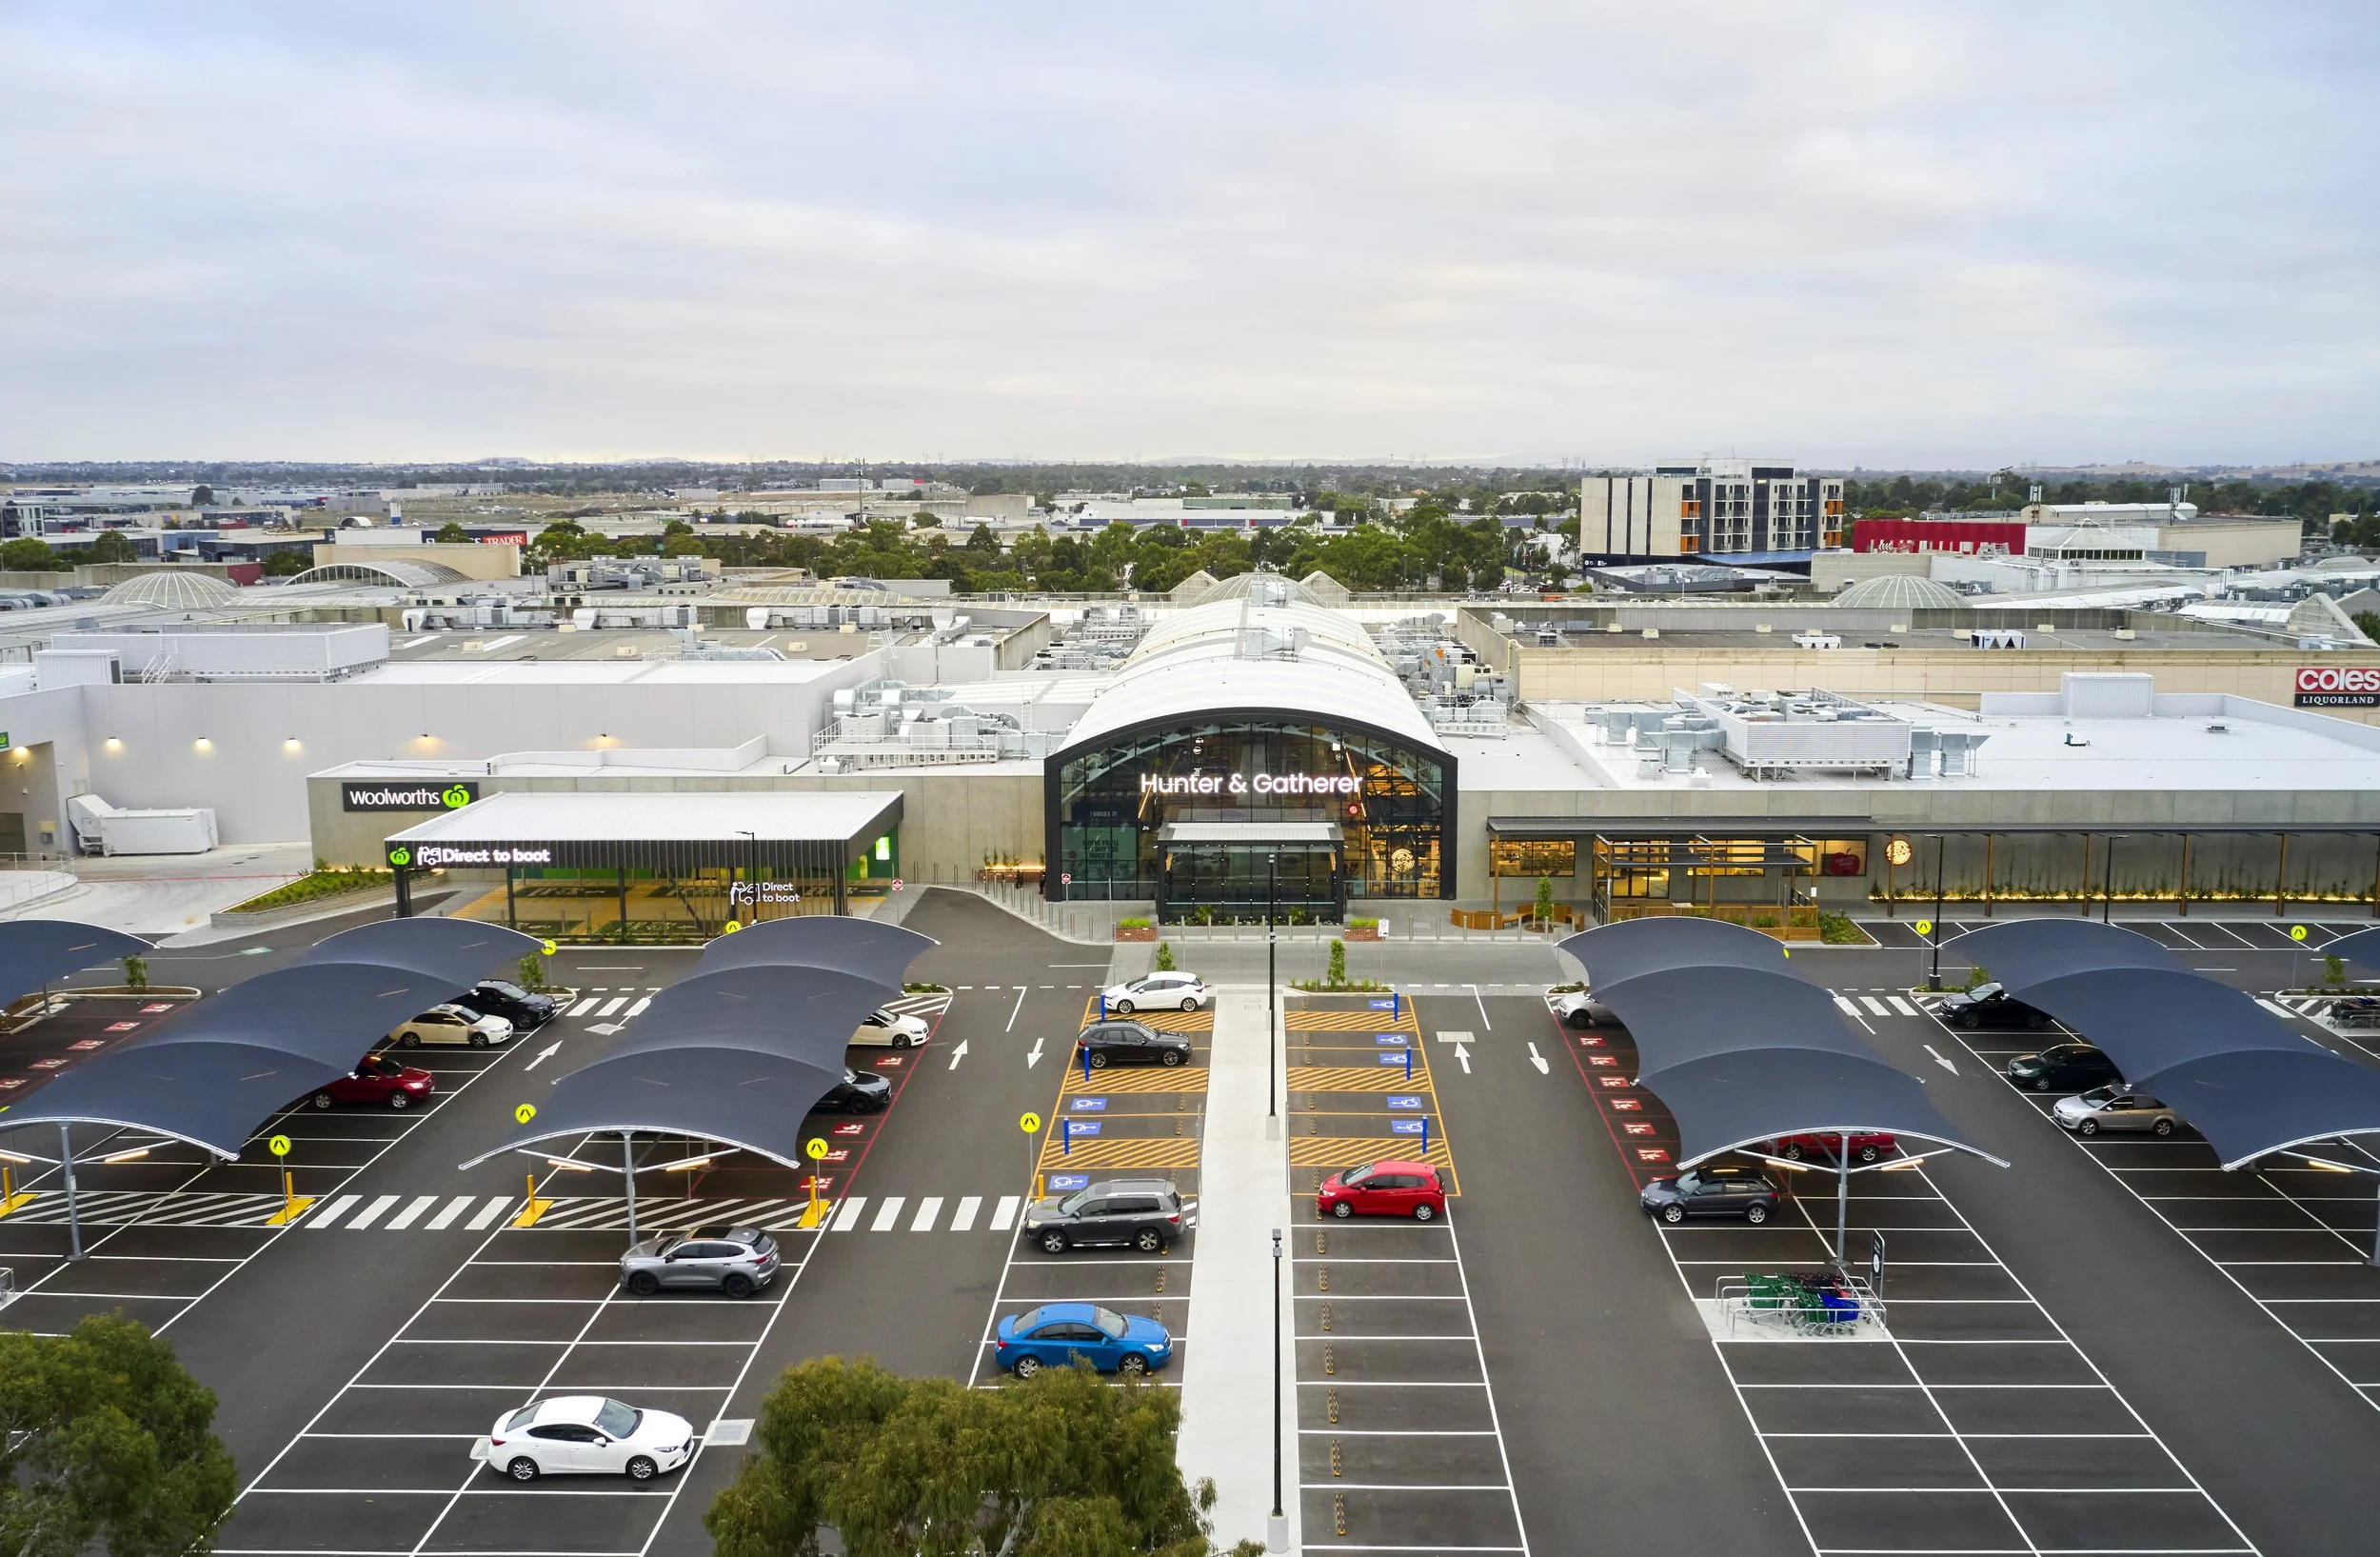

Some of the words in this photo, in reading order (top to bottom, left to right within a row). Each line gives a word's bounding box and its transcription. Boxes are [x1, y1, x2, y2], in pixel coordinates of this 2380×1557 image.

[486, 535, 523, 546] TRADER
[2298, 669, 2380, 691] coles
[2302, 696, 2374, 706] LIQUORLAND
[1140, 773, 1222, 793] Hunter
[1228, 773, 1247, 793] &
[1253, 772, 1363, 793] Gatherer
[349, 788, 440, 805] Woolworths
[442, 848, 490, 863] Direct
[492, 849, 511, 863] to
[512, 848, 551, 863] boot
[762, 882, 794, 891] Direct
[762, 893, 774, 903] to
[775, 892, 800, 903] boot
